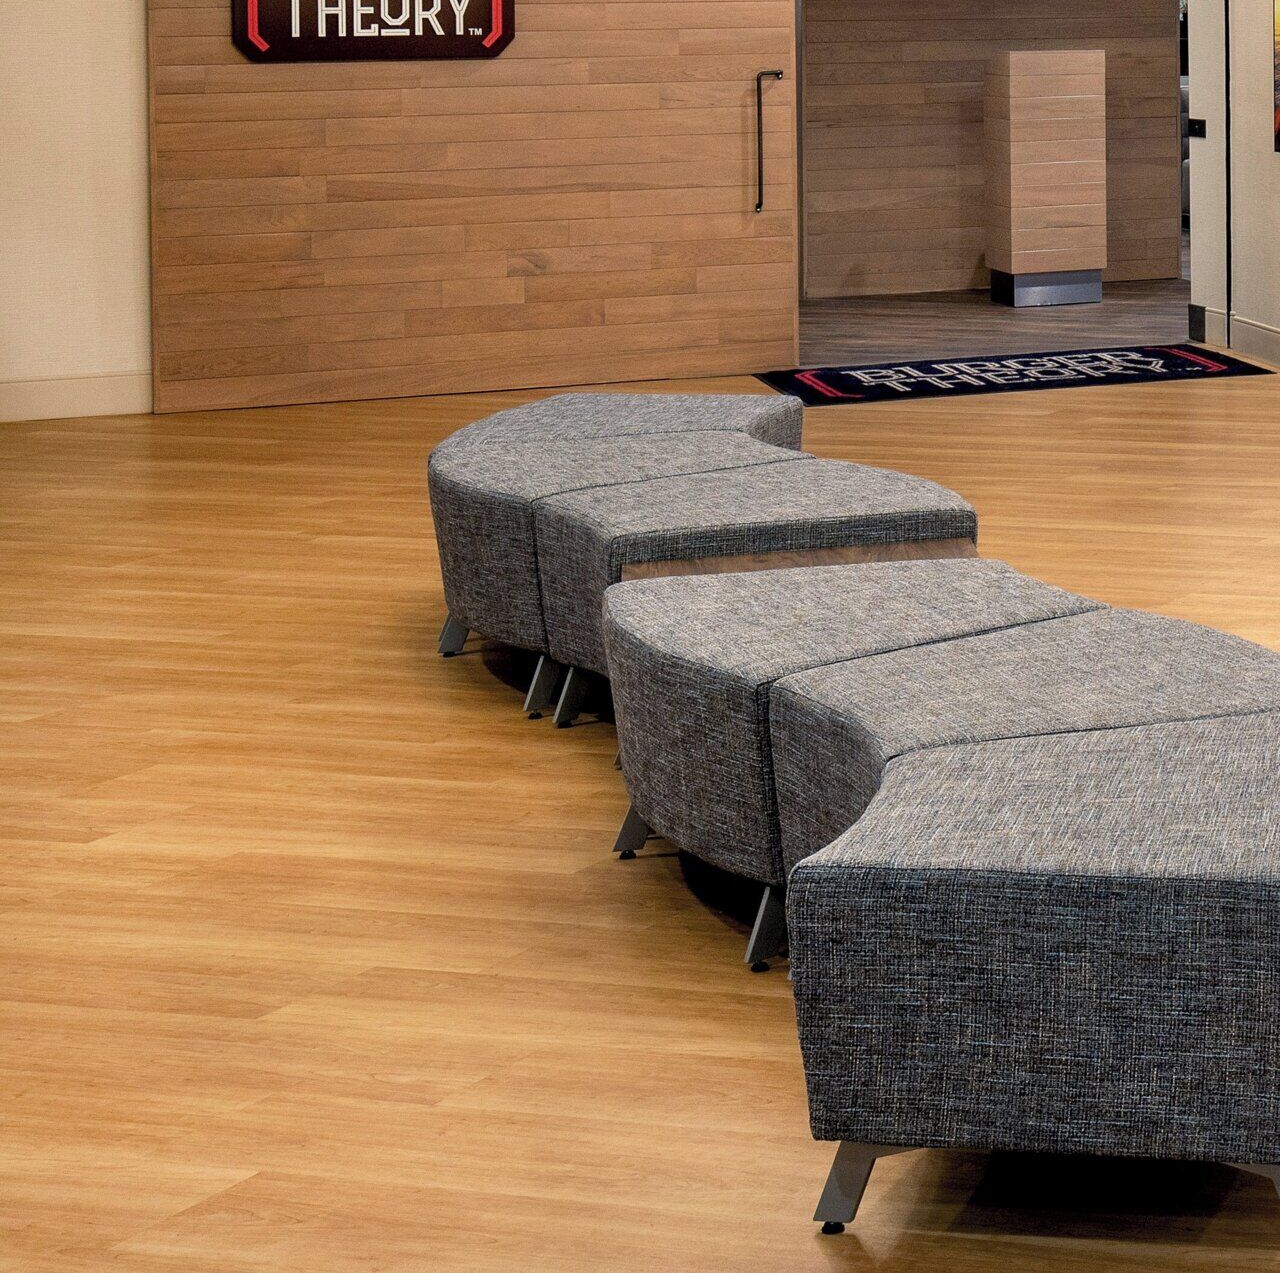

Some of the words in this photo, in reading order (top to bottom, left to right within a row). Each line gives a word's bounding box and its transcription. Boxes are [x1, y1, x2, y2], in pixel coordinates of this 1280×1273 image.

[468, 28, 483, 36] TM
[841, 351, 1146, 383] BURGER
[862, 358, 1168, 392] THEORY
